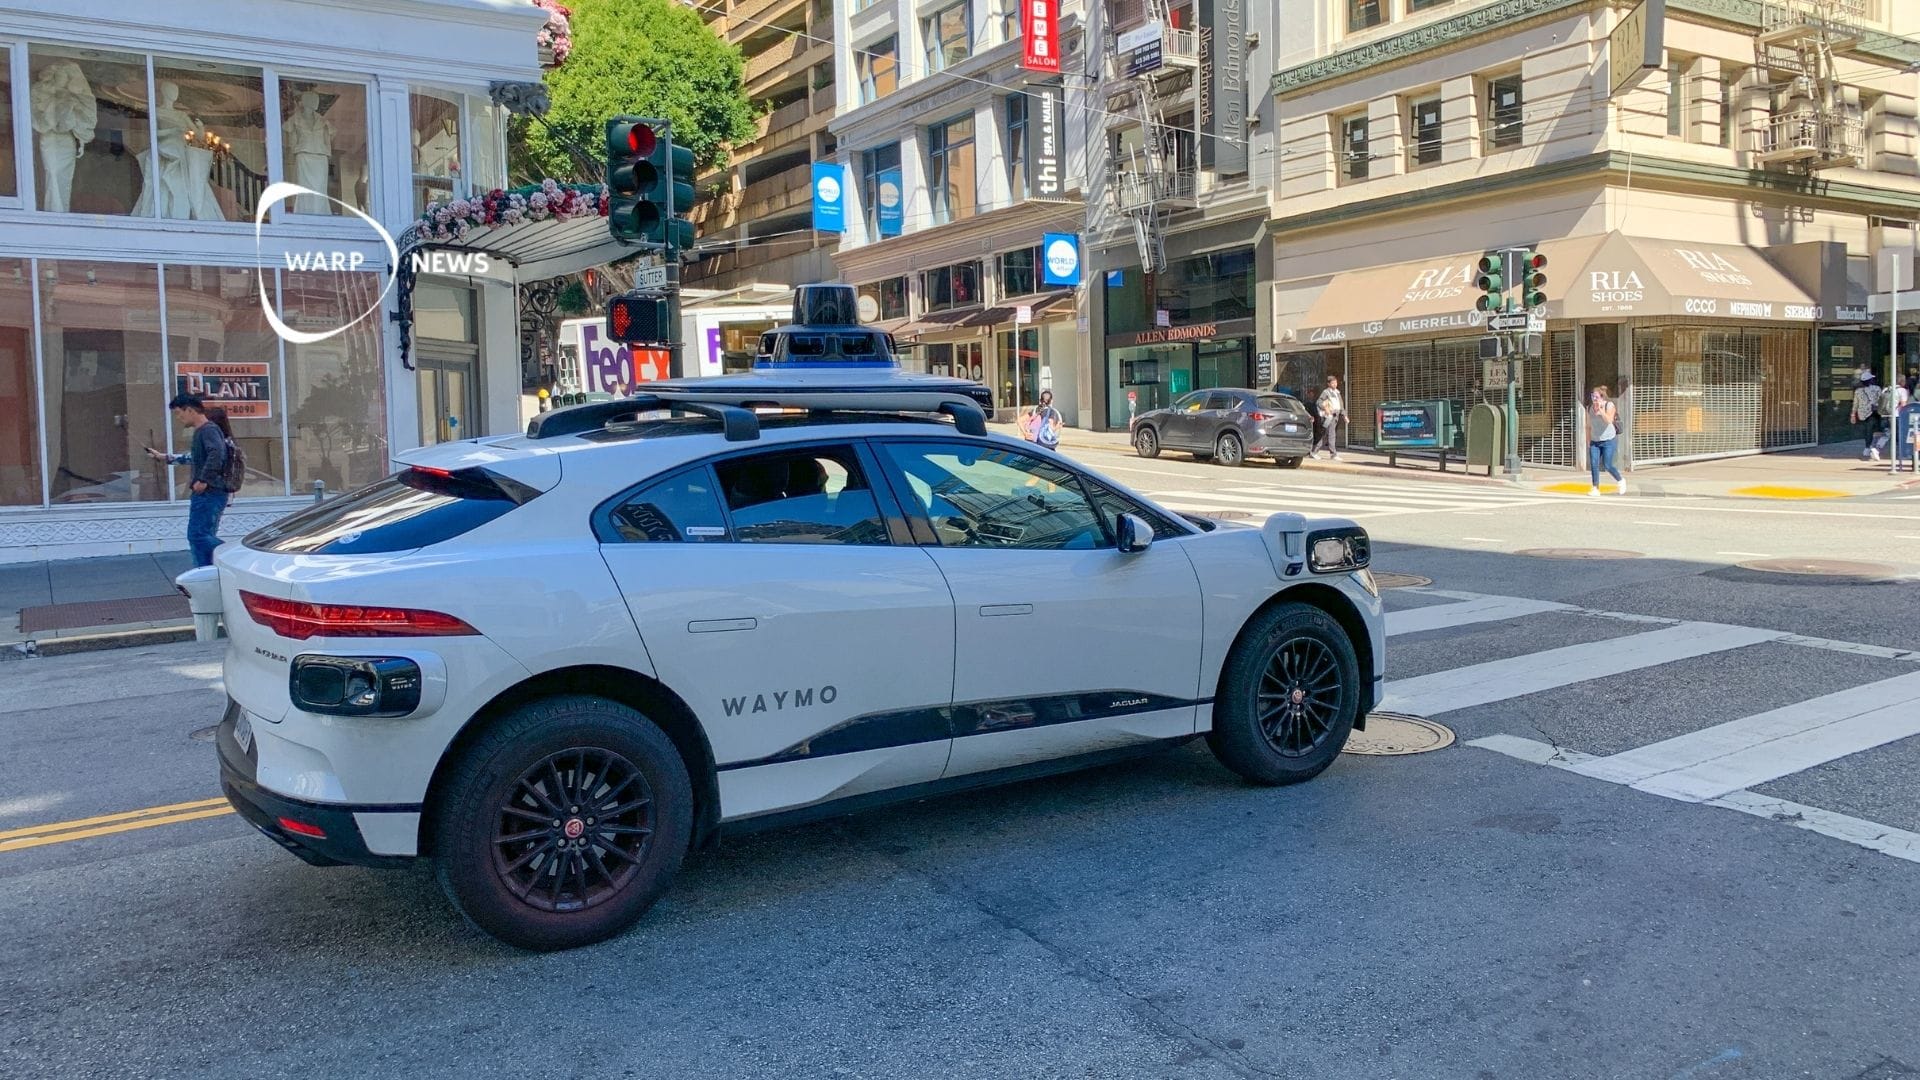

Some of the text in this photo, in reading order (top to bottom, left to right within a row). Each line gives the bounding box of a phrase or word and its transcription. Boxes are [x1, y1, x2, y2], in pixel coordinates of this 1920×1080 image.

[1027, 56, 1057, 66] SALON
[1200, 25, 1213, 126] Allen Edmonds
[1221, 0, 1240, 151] Allen Edmonds
[1038, 91, 1057, 194] thi SPA & NAILS
[1049, 256, 1075, 265] WORLD
[1674, 248, 1740, 272] RIA
[640, 270, 663, 285] SUTTER
[1408, 264, 1472, 290] RIA
[1590, 270, 1645, 291] RIA
[1700, 271, 1752, 285] SHOES
[1404, 286, 1465, 302] SHOES
[1592, 290, 1643, 302] SHOES
[1685, 298, 1716, 314] ecco
[1730, 301, 1763, 317] MEPHISTO
[1784, 304, 1823, 319] SEBAGO
[1363, 321, 1383, 334] UGG
[1400, 315, 1466, 331] MERRELL
[1135, 324, 1217, 345] ALLEN EDMONDS
[1310, 327, 1346, 343] Clarks
[583, 325, 670, 397] FedEx
[1259, 353, 1270, 362] 310
[204, 366, 251, 374] FOR LEASE
[722, 685, 837, 717] WAYMO
[1109, 698, 1148, 708] JAGUAR
